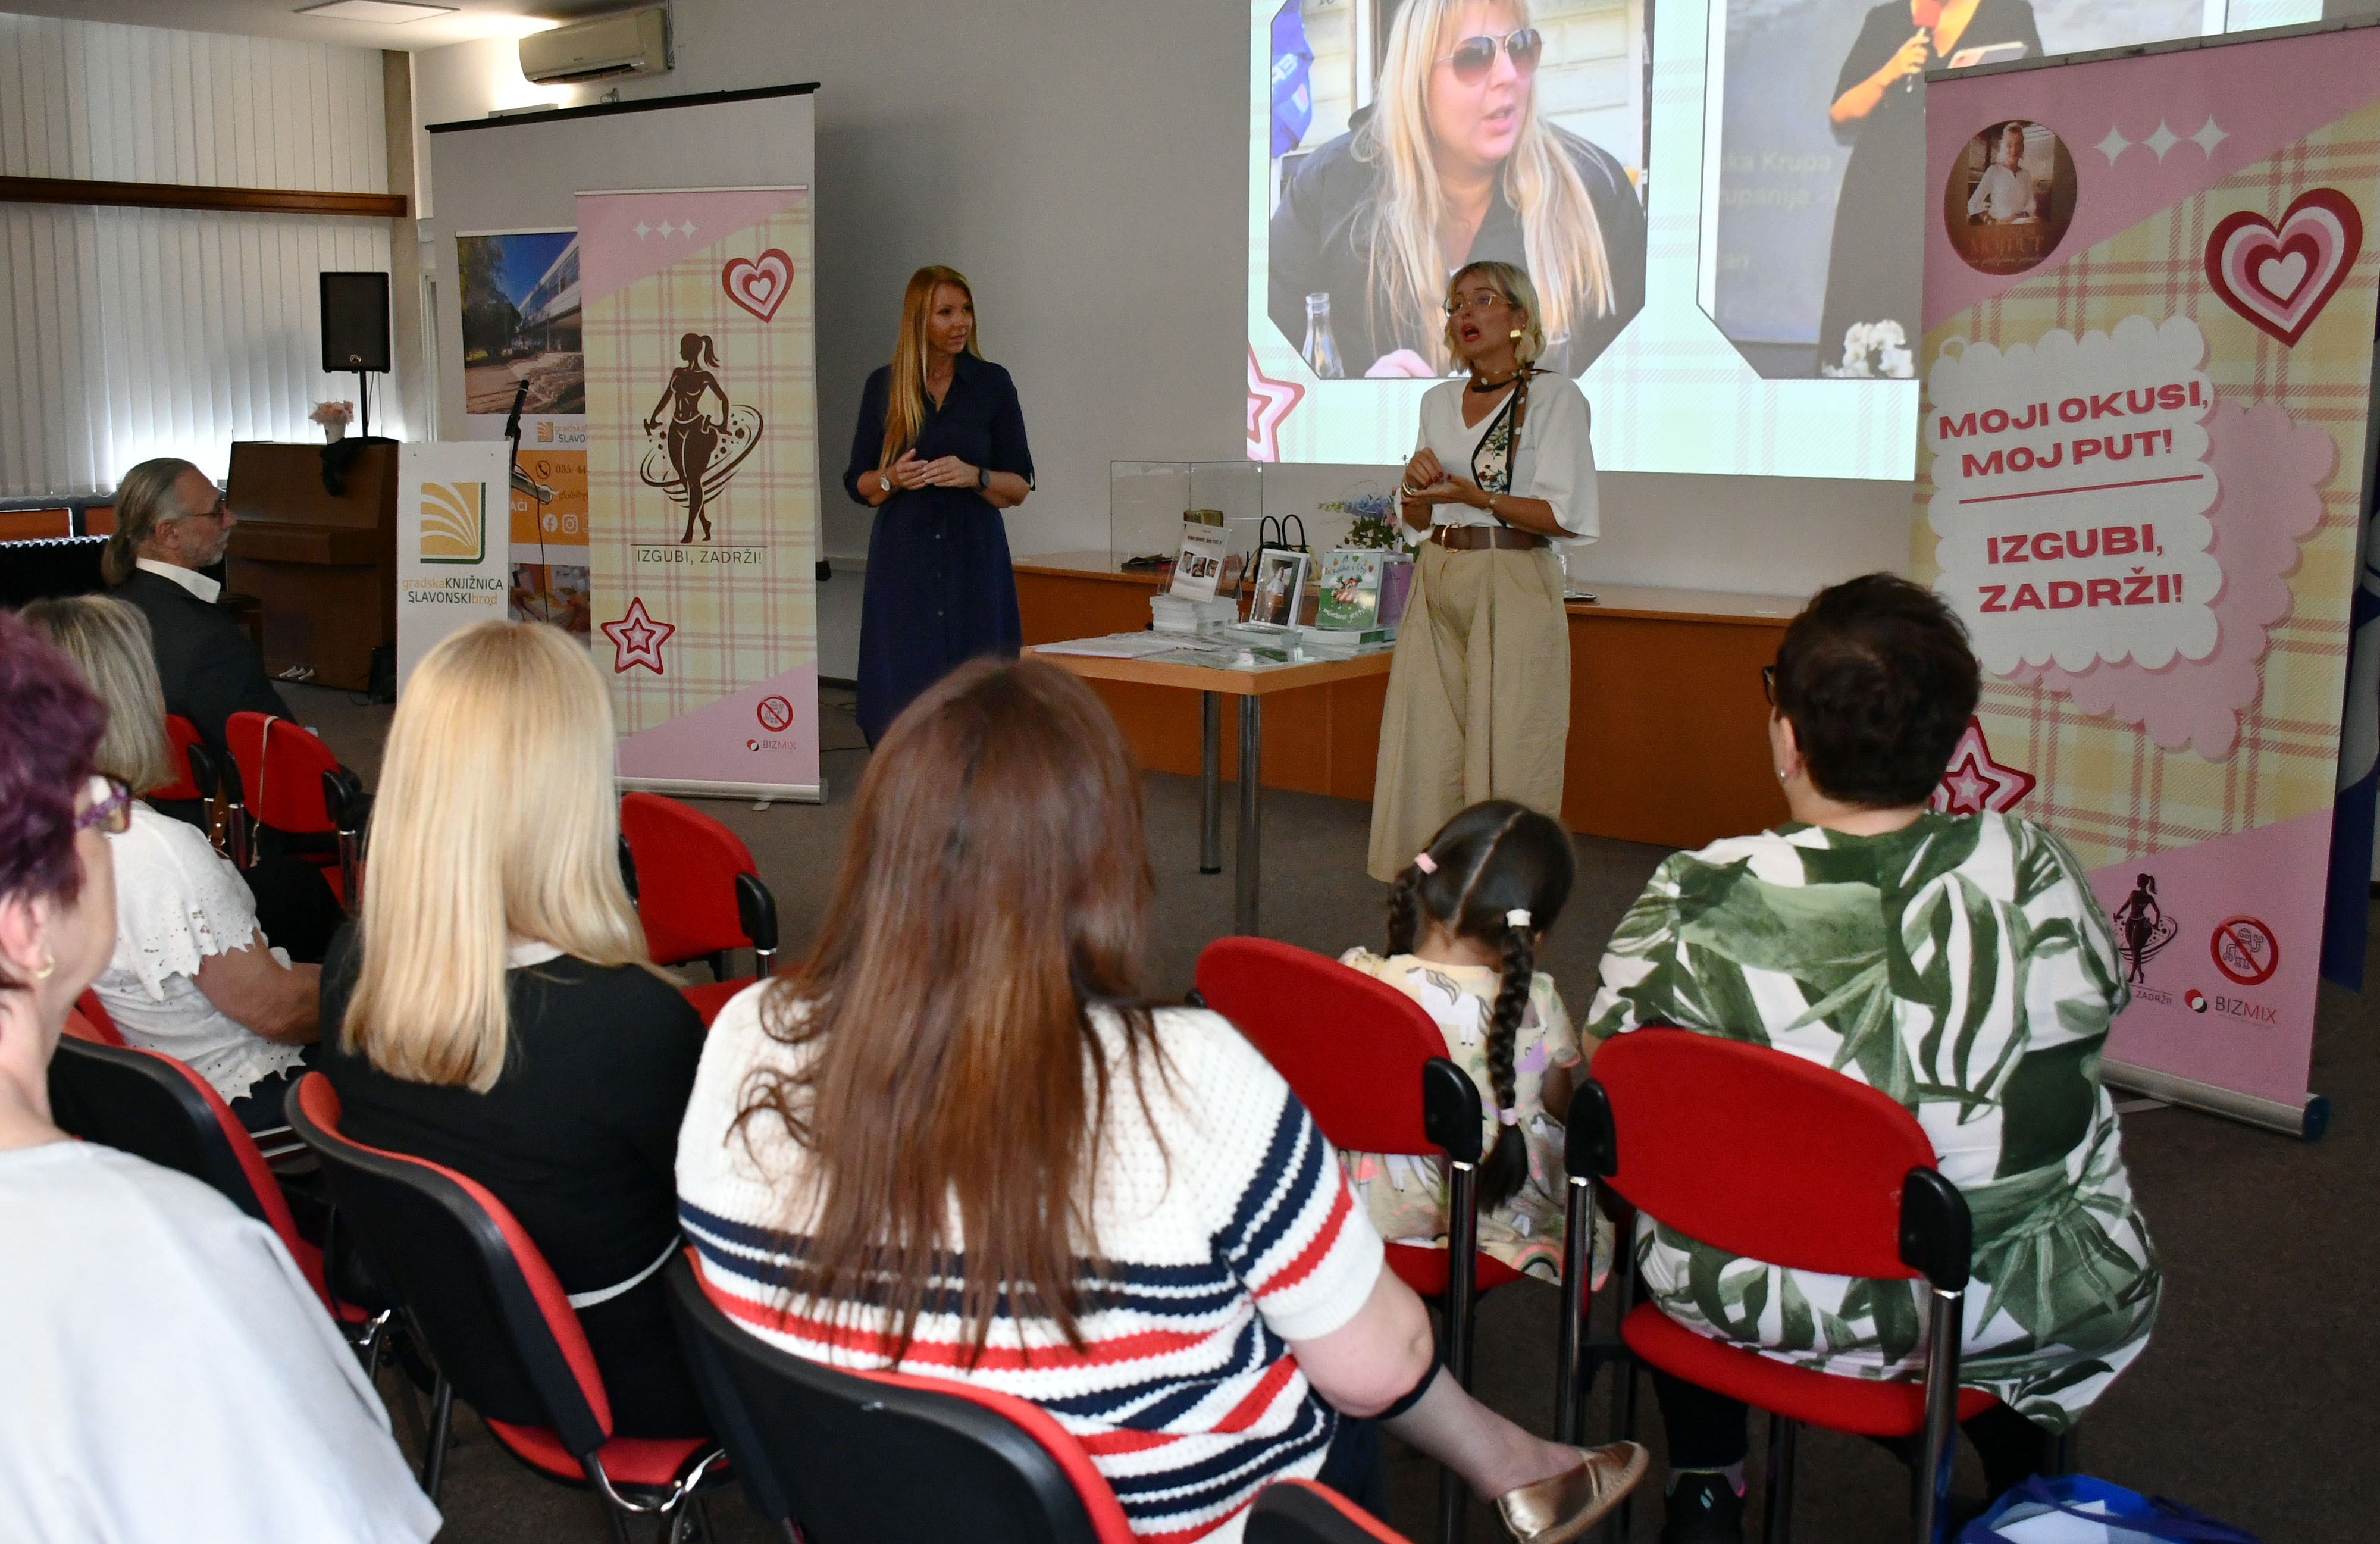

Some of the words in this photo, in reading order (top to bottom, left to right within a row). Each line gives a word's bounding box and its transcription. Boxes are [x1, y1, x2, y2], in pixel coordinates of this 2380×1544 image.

[1939, 403, 2049, 440] MOJI
[2058, 381, 2209, 424] OKUSI,
[555, 424, 587, 434] gradska
[1961, 443, 2063, 478] MOJ
[2072, 428, 2172, 465] PUT!
[637, 549, 694, 565] IZGUBI,
[700, 548, 762, 564] ZADRŽI!
[1987, 524, 2163, 565] IZGUBI,
[1978, 566, 2183, 613] ZADRŽI!
[763, 740, 796, 750] BIZMIX
[2215, 995, 2278, 1024] BIZMIX
